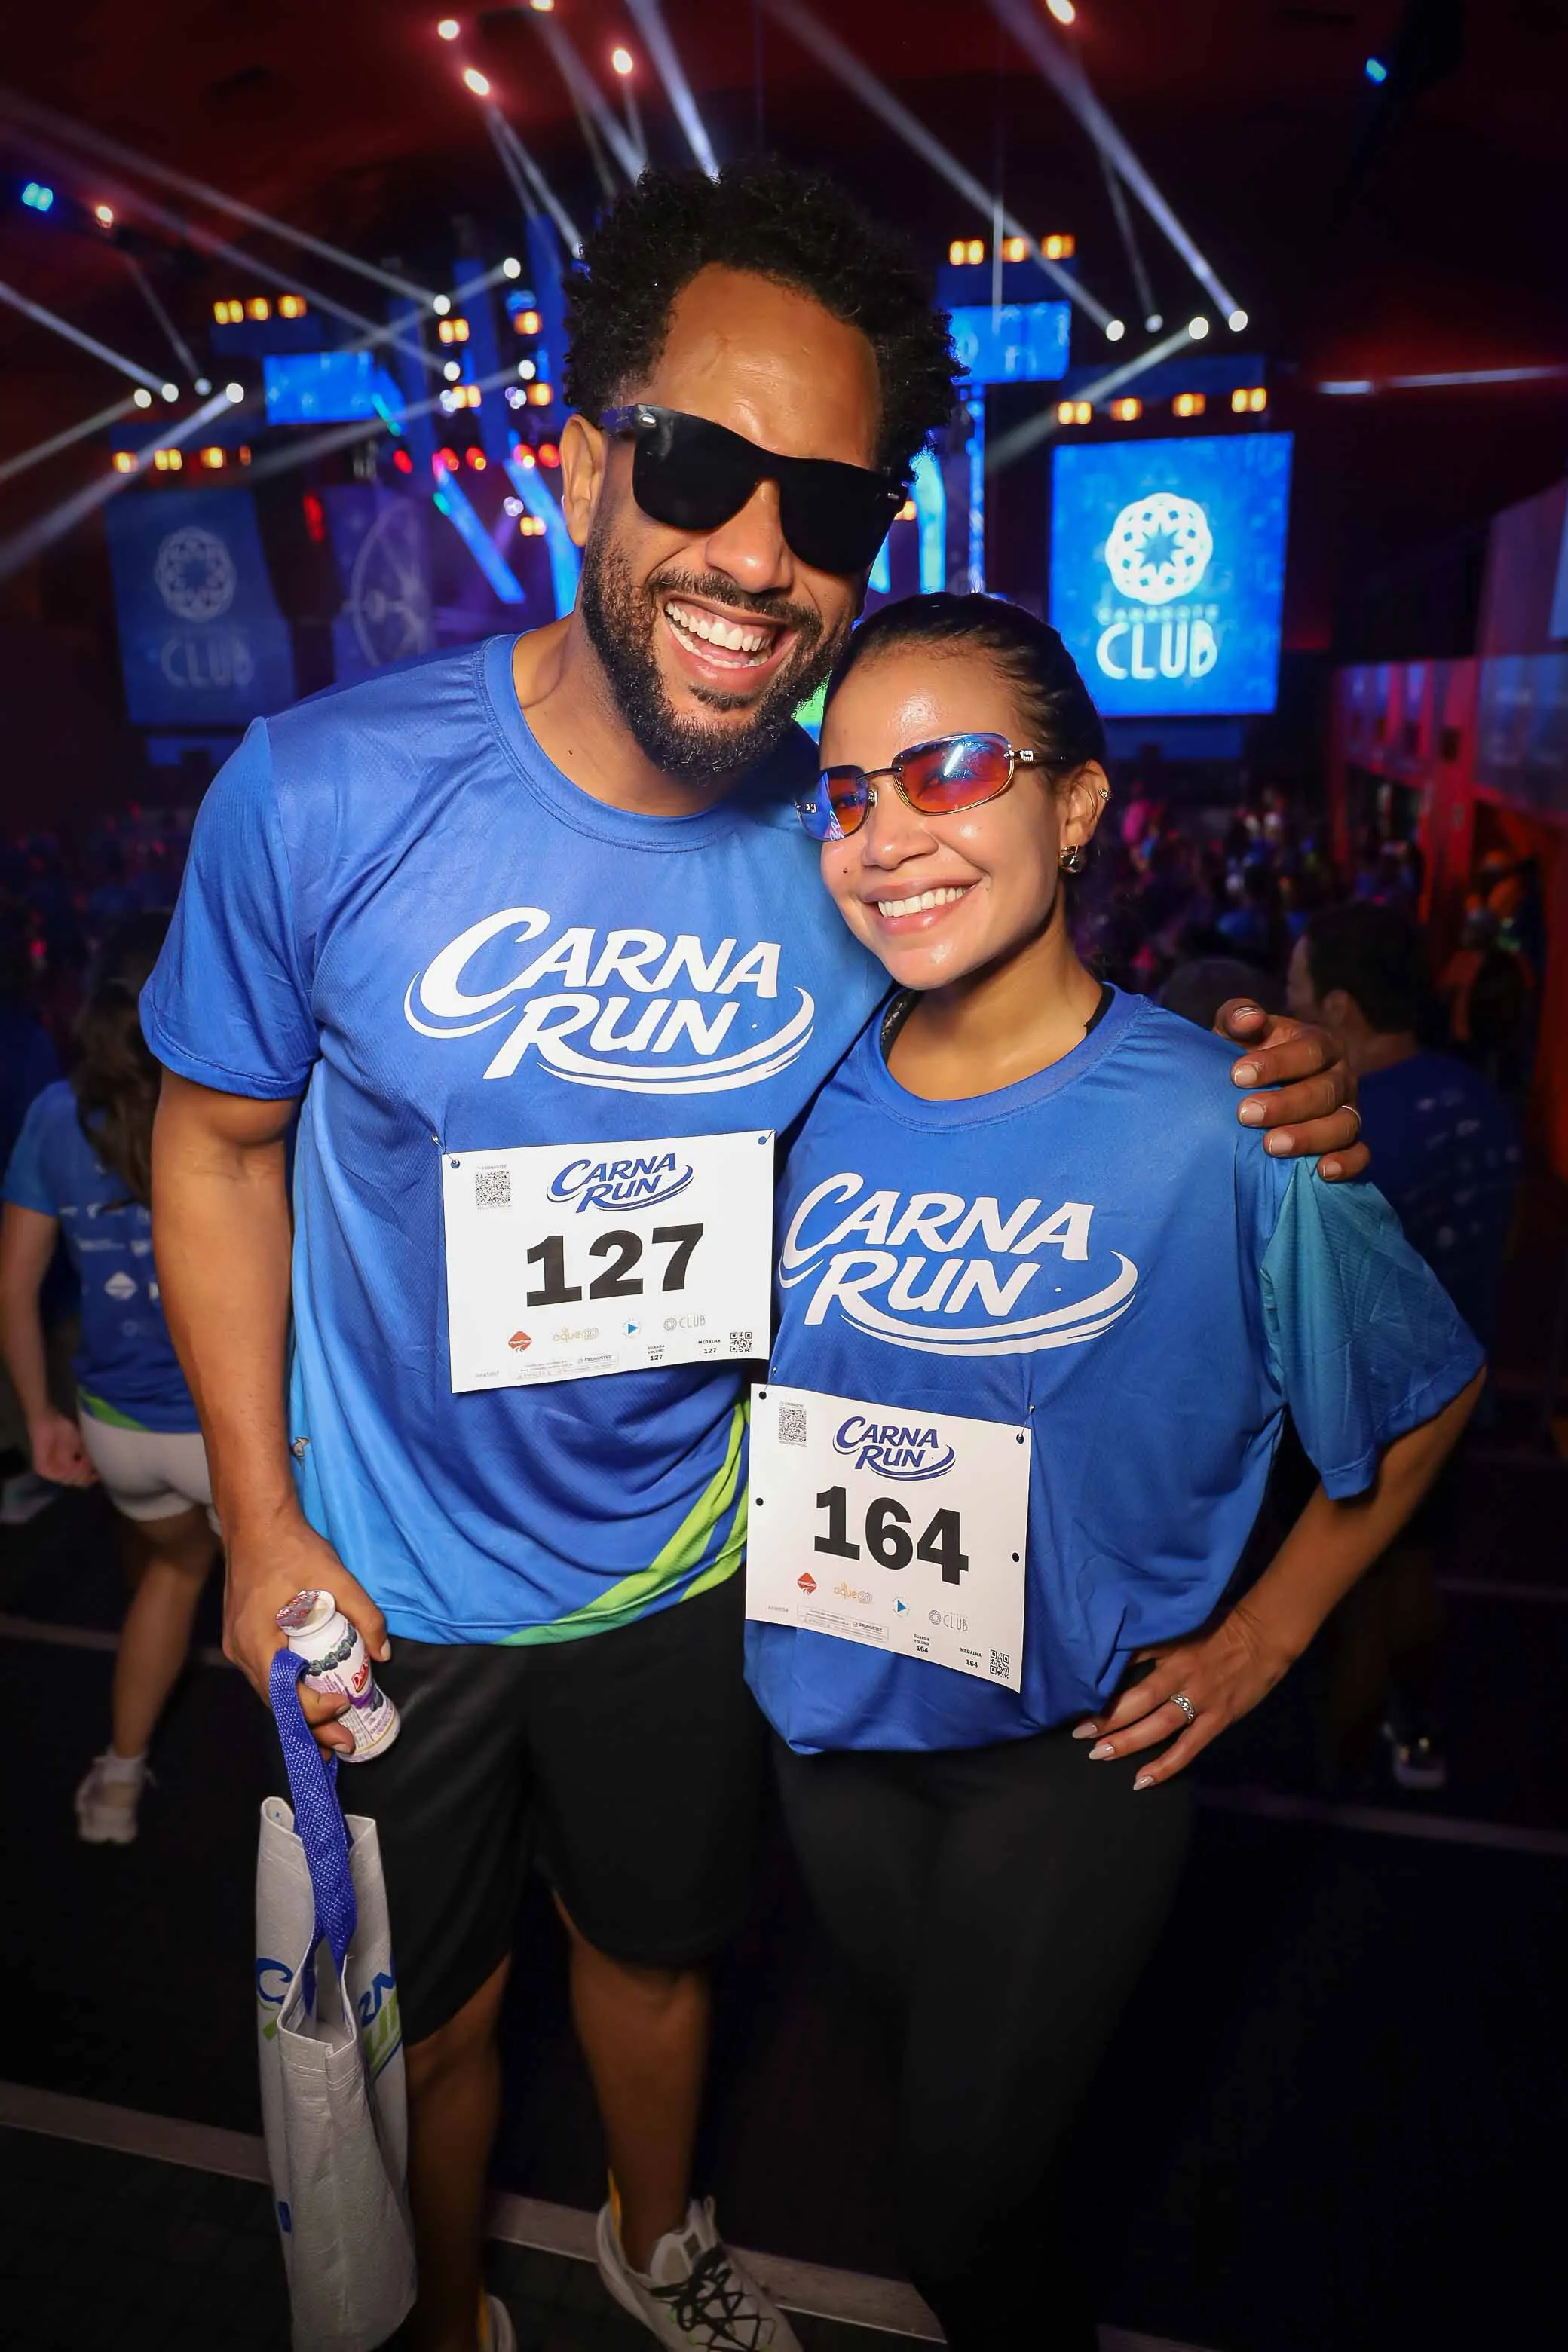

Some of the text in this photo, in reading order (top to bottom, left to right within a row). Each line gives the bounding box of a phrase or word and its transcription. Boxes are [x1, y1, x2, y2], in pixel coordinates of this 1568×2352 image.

[160, 635, 256, 689] CLUB
[1096, 619, 1218, 680] CLUB
[419, 906, 782, 1018] CARNA
[482, 992, 740, 1080] RUN
[550, 1153, 677, 1196] CARNA
[575, 1174, 660, 1213] RUN
[782, 1172, 1095, 1268] CARNA
[527, 1223, 704, 1307] 127
[804, 1250, 1041, 1325] RUN
[678, 1315, 706, 1329] CLUB
[835, 1416, 939, 1448] CARNA
[854, 1445, 926, 1470] RUN
[813, 1485, 969, 1586] 164
[942, 1614, 969, 1632] CLUB
[960, 1647, 982, 1658] MEDALHA
[965, 1658, 978, 1668] 164
